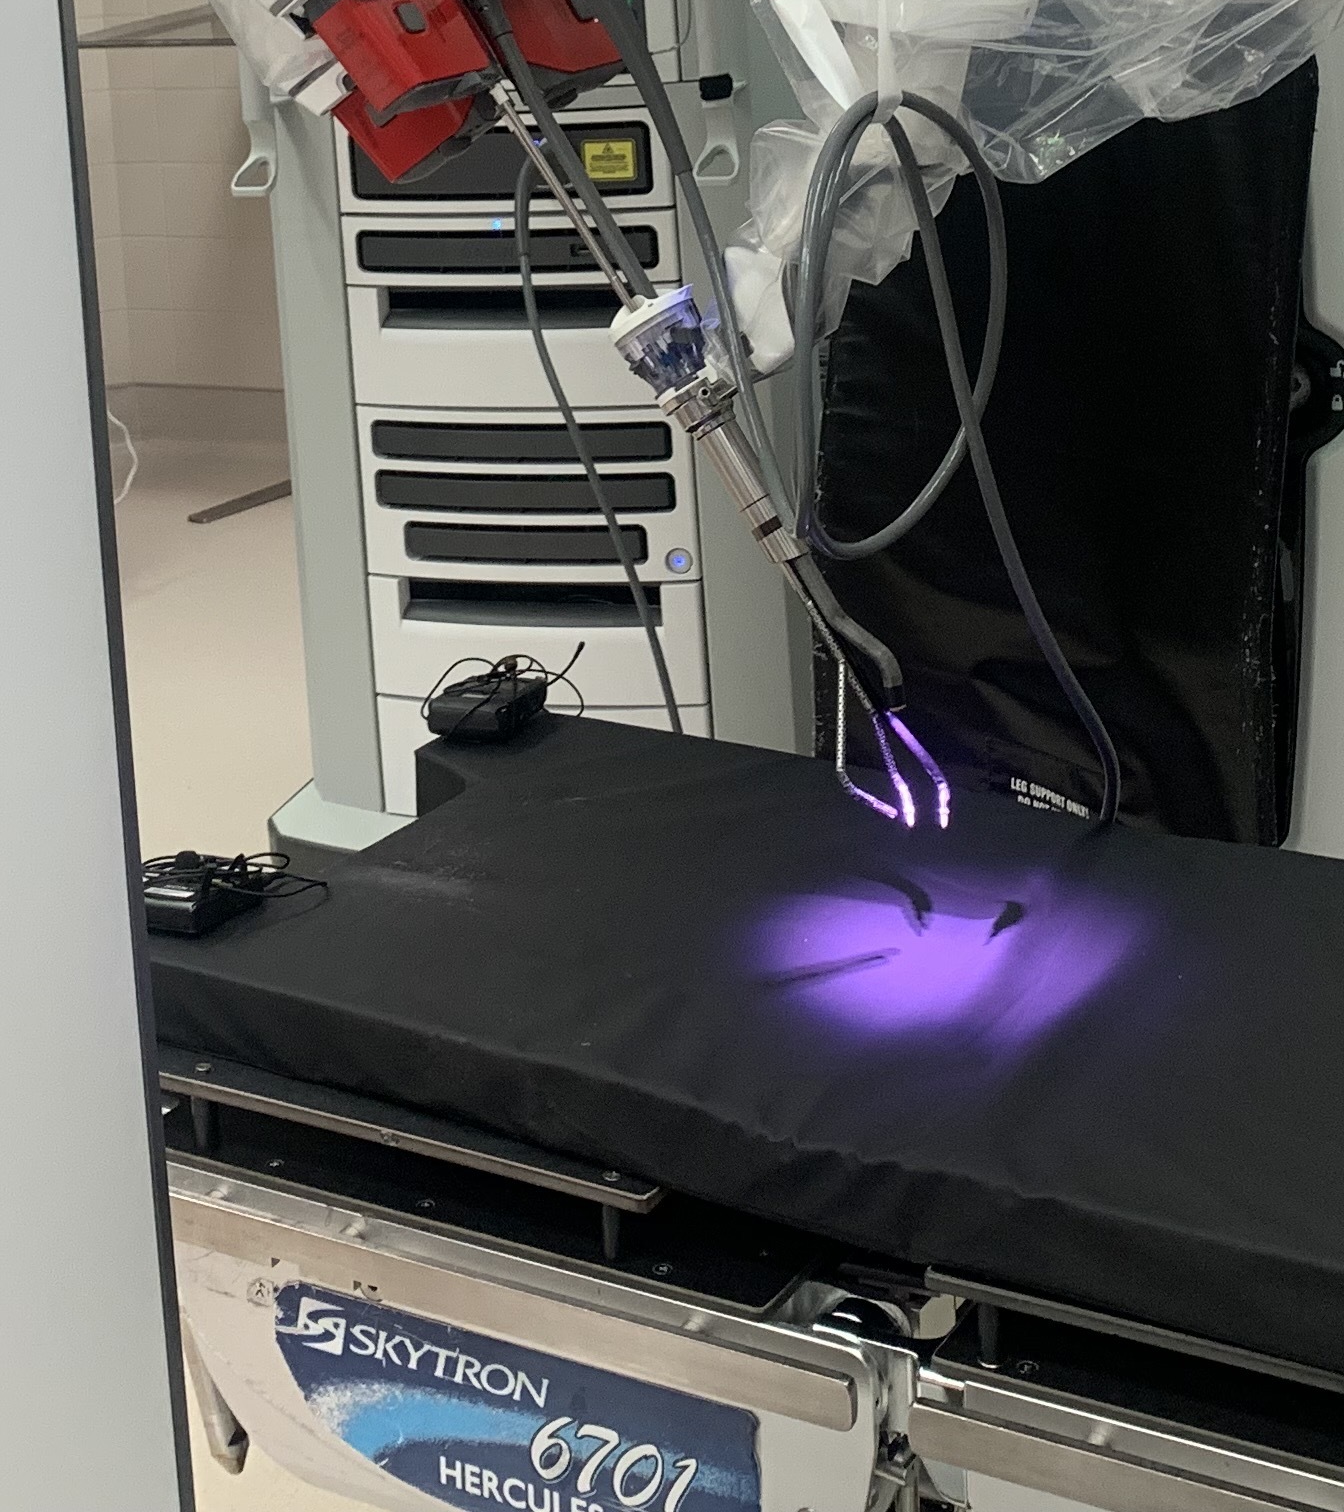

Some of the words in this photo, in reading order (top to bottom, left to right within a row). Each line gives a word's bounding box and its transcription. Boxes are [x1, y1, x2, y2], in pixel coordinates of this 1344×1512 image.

[1010, 776, 1028, 793] LEG
[1029, 782, 1066, 808] SUPPORT
[1066, 799, 1090, 820] ONLY!
[349, 1324, 549, 1409] SKYTRON
[438, 1454, 604, 1512] HERCUL
[529, 1415, 699, 1512] 6701
